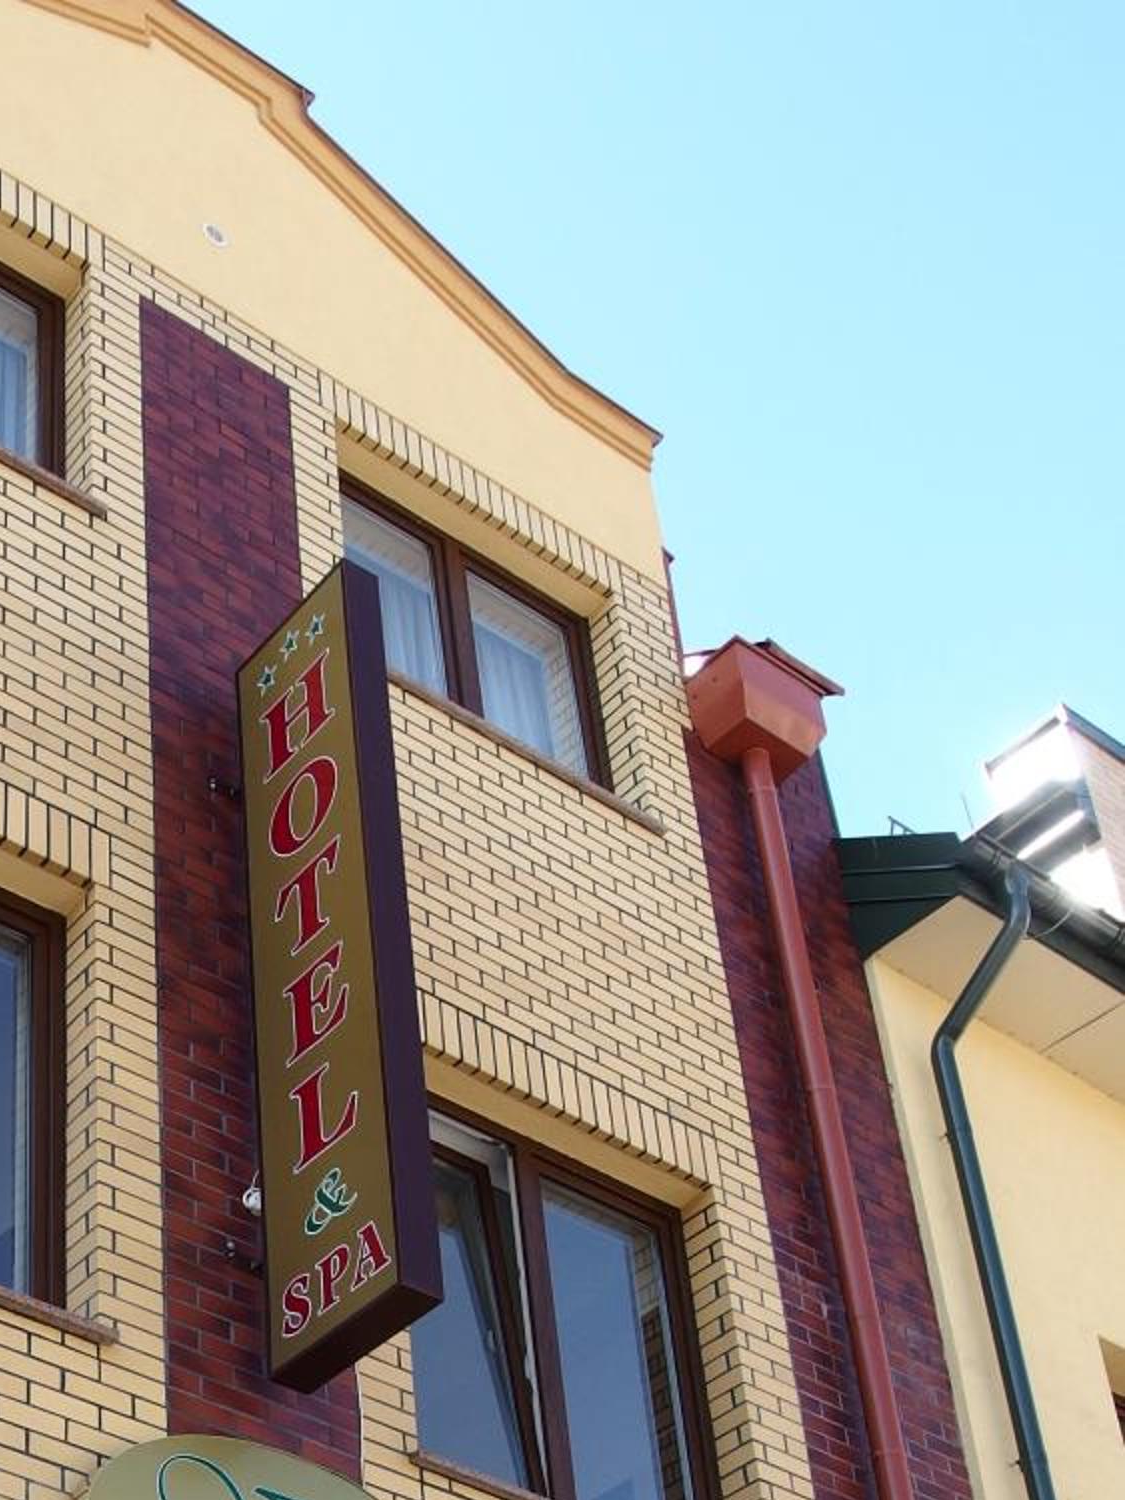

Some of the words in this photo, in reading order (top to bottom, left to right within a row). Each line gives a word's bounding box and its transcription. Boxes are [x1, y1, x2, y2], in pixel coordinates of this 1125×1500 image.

[259, 646, 357, 1175] HOTEL
[304, 1167, 358, 1235] &
[282, 1220, 391, 1338] SPA
